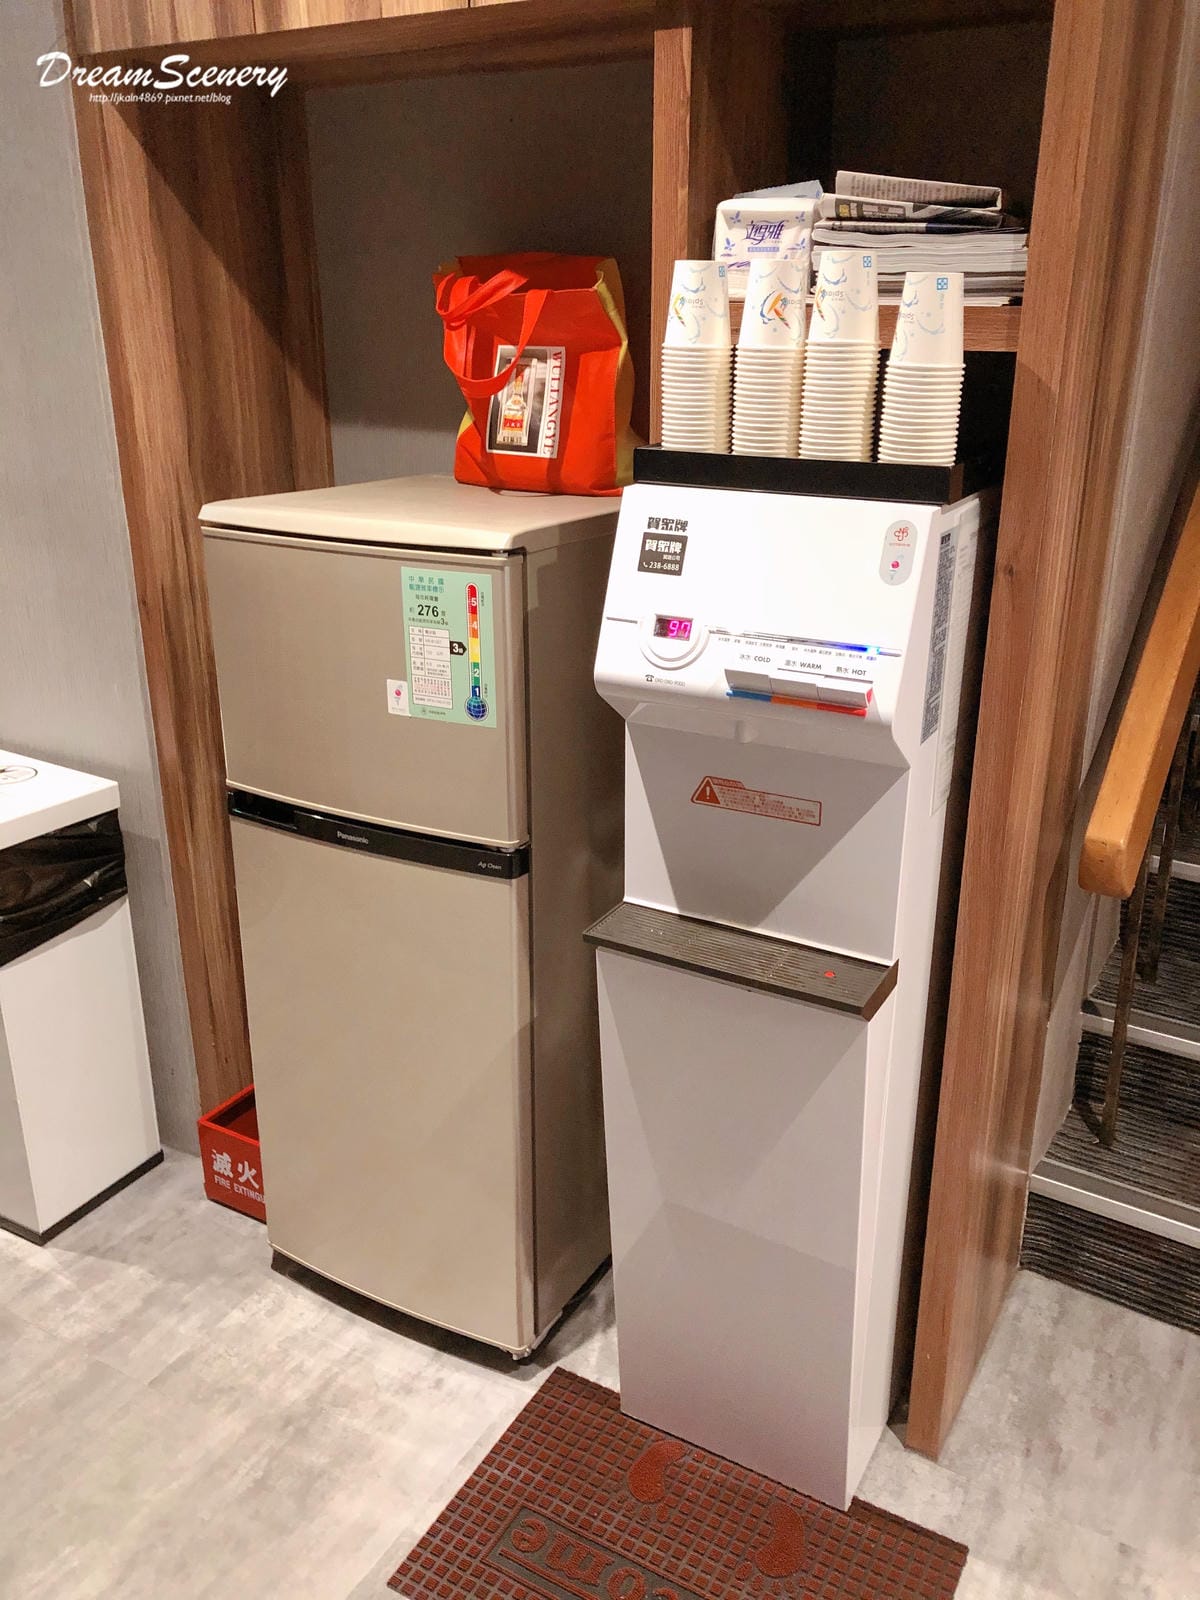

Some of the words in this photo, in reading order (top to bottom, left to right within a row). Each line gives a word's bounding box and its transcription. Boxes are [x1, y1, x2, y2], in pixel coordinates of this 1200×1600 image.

[543, 351, 562, 456] WULIANGYE
[471, 597, 477, 606] 5
[417, 604, 439, 617] 276
[472, 621, 478, 630] 4
[452, 643, 459, 653] 3
[754, 655, 771, 663] COLD
[799, 661, 822, 670] WARM
[474, 668, 480, 678] 2
[475, 687, 480, 696] 1
[336, 830, 369, 845] Panasonic
[214, 1175, 231, 1190] FIRE
